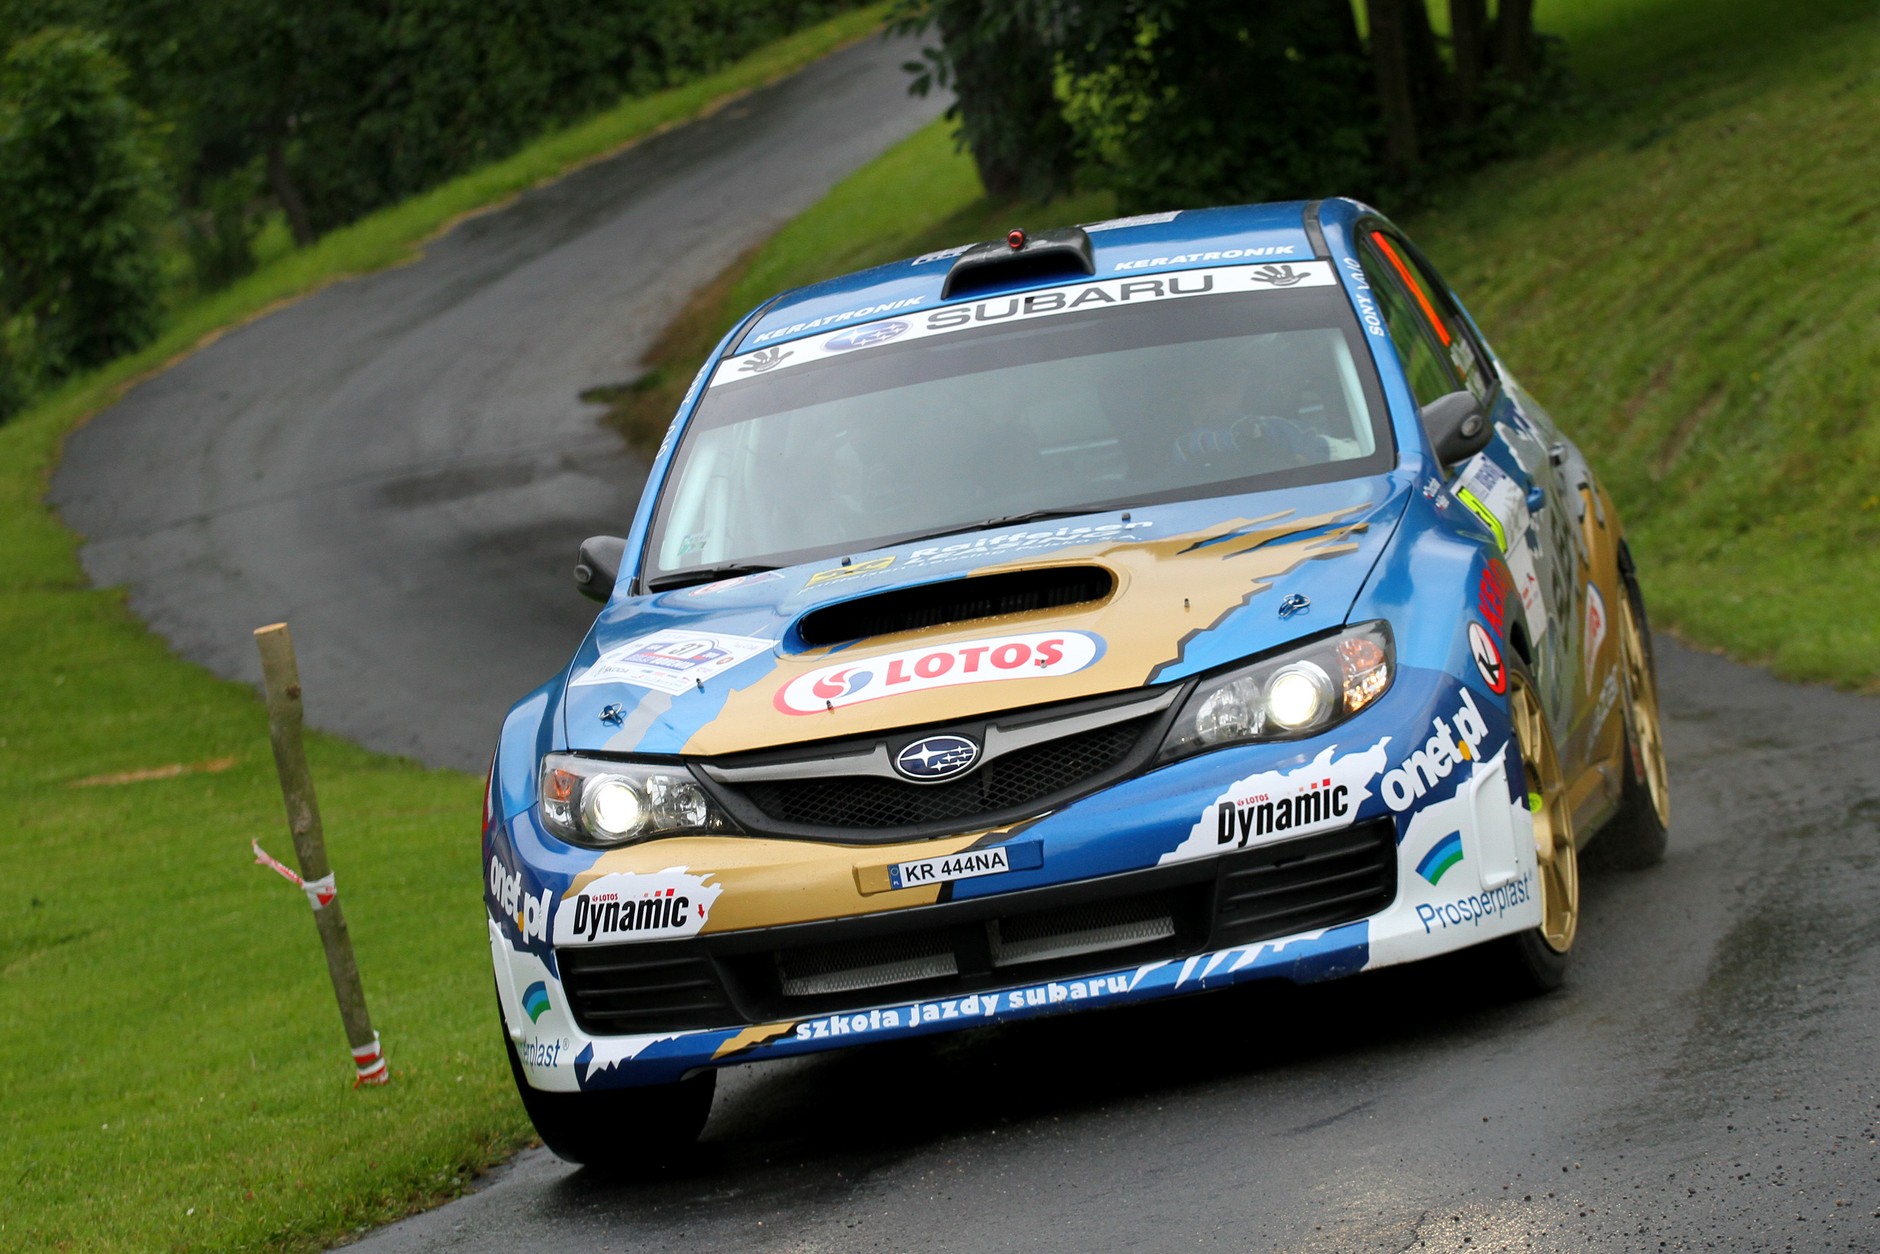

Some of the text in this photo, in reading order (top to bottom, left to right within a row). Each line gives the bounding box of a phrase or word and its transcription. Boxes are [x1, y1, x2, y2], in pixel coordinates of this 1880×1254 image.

[1114, 245, 1295, 272] KERATRONIK
[753, 296, 925, 343] KERATRONIK
[926, 275, 1214, 331] SUBARU
[1343, 257, 1385, 337] SONY VAIO
[903, 530, 1120, 566] LEASING
[909, 521, 1153, 559] Raiffeisen
[885, 638, 1064, 686] LOTOS
[1381, 687, 1489, 812] onet.pl
[1217, 778, 1349, 849] Dynamic
[1245, 793, 1269, 805] LOTOS
[905, 851, 1007, 883] KR 444NA
[491, 855, 553, 945] onet.pl
[573, 888, 690, 942] Dynamic
[599, 893, 618, 902] LOTOS
[1415, 875, 1531, 935] Prosperplast
[796, 975, 1129, 1041] szkoła jazdy subaru
